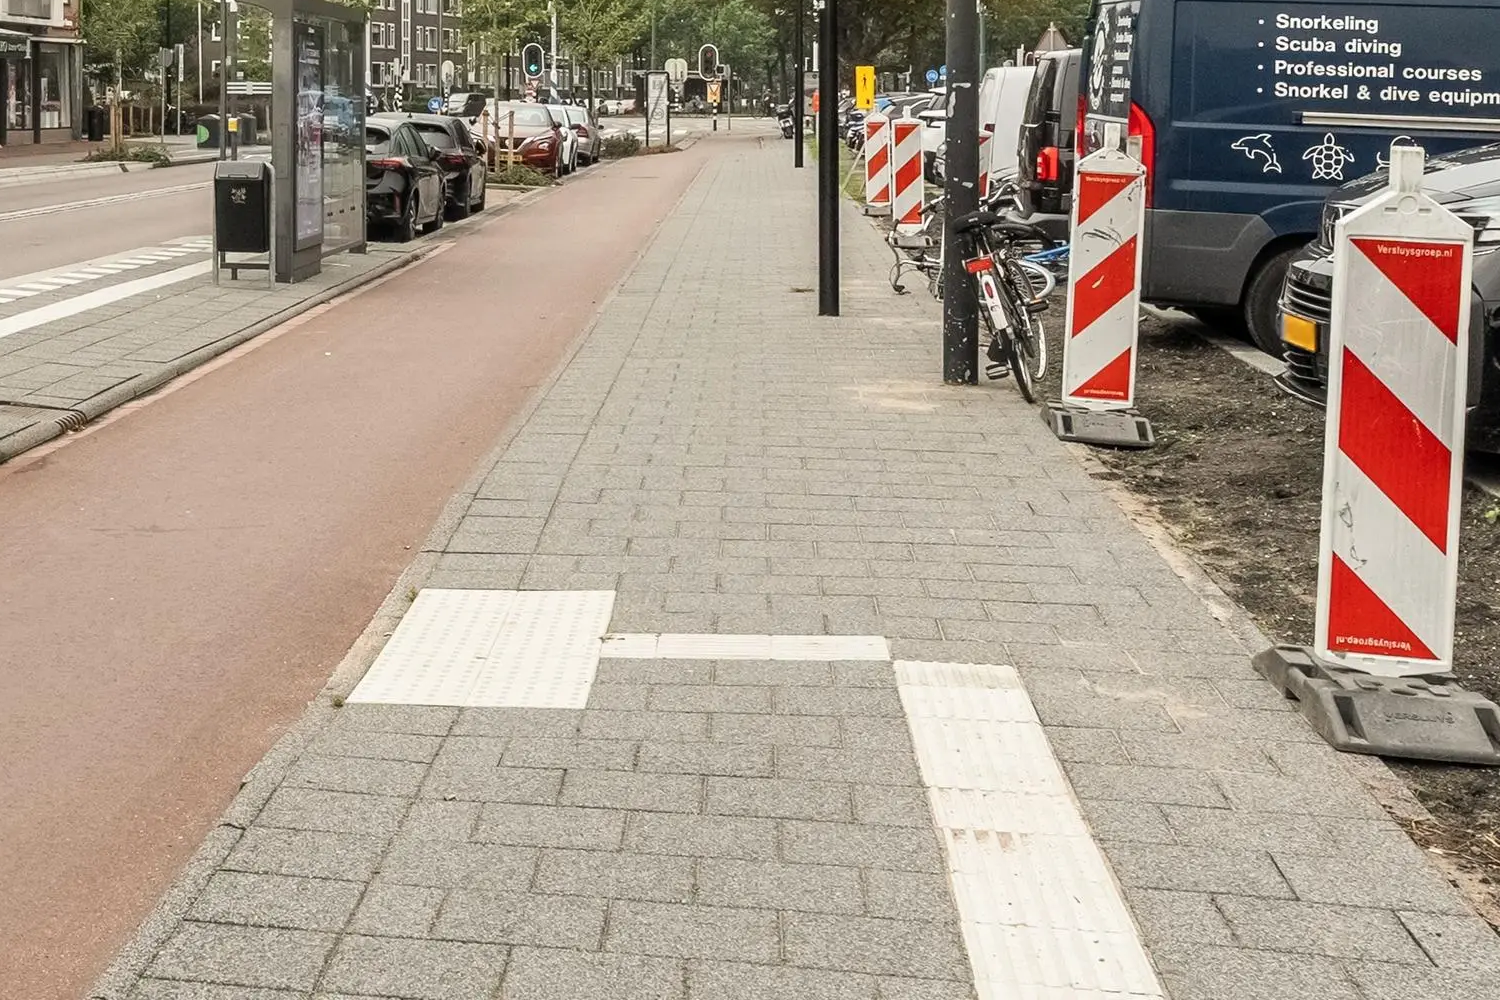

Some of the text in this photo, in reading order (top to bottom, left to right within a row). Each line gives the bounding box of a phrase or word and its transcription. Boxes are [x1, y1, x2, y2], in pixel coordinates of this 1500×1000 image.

[1276, 13, 1379, 34] Snorkeling
[1275, 36, 1402, 57] Scuba diving
[1274, 59, 1482, 81] Professional courses
[1274, 82, 1348, 100] Snorkel
[1356, 85, 1371, 101] &
[1380, 86, 1420, 102] dive
[1376, 244, 1453, 258] Versluysgroep.nl
